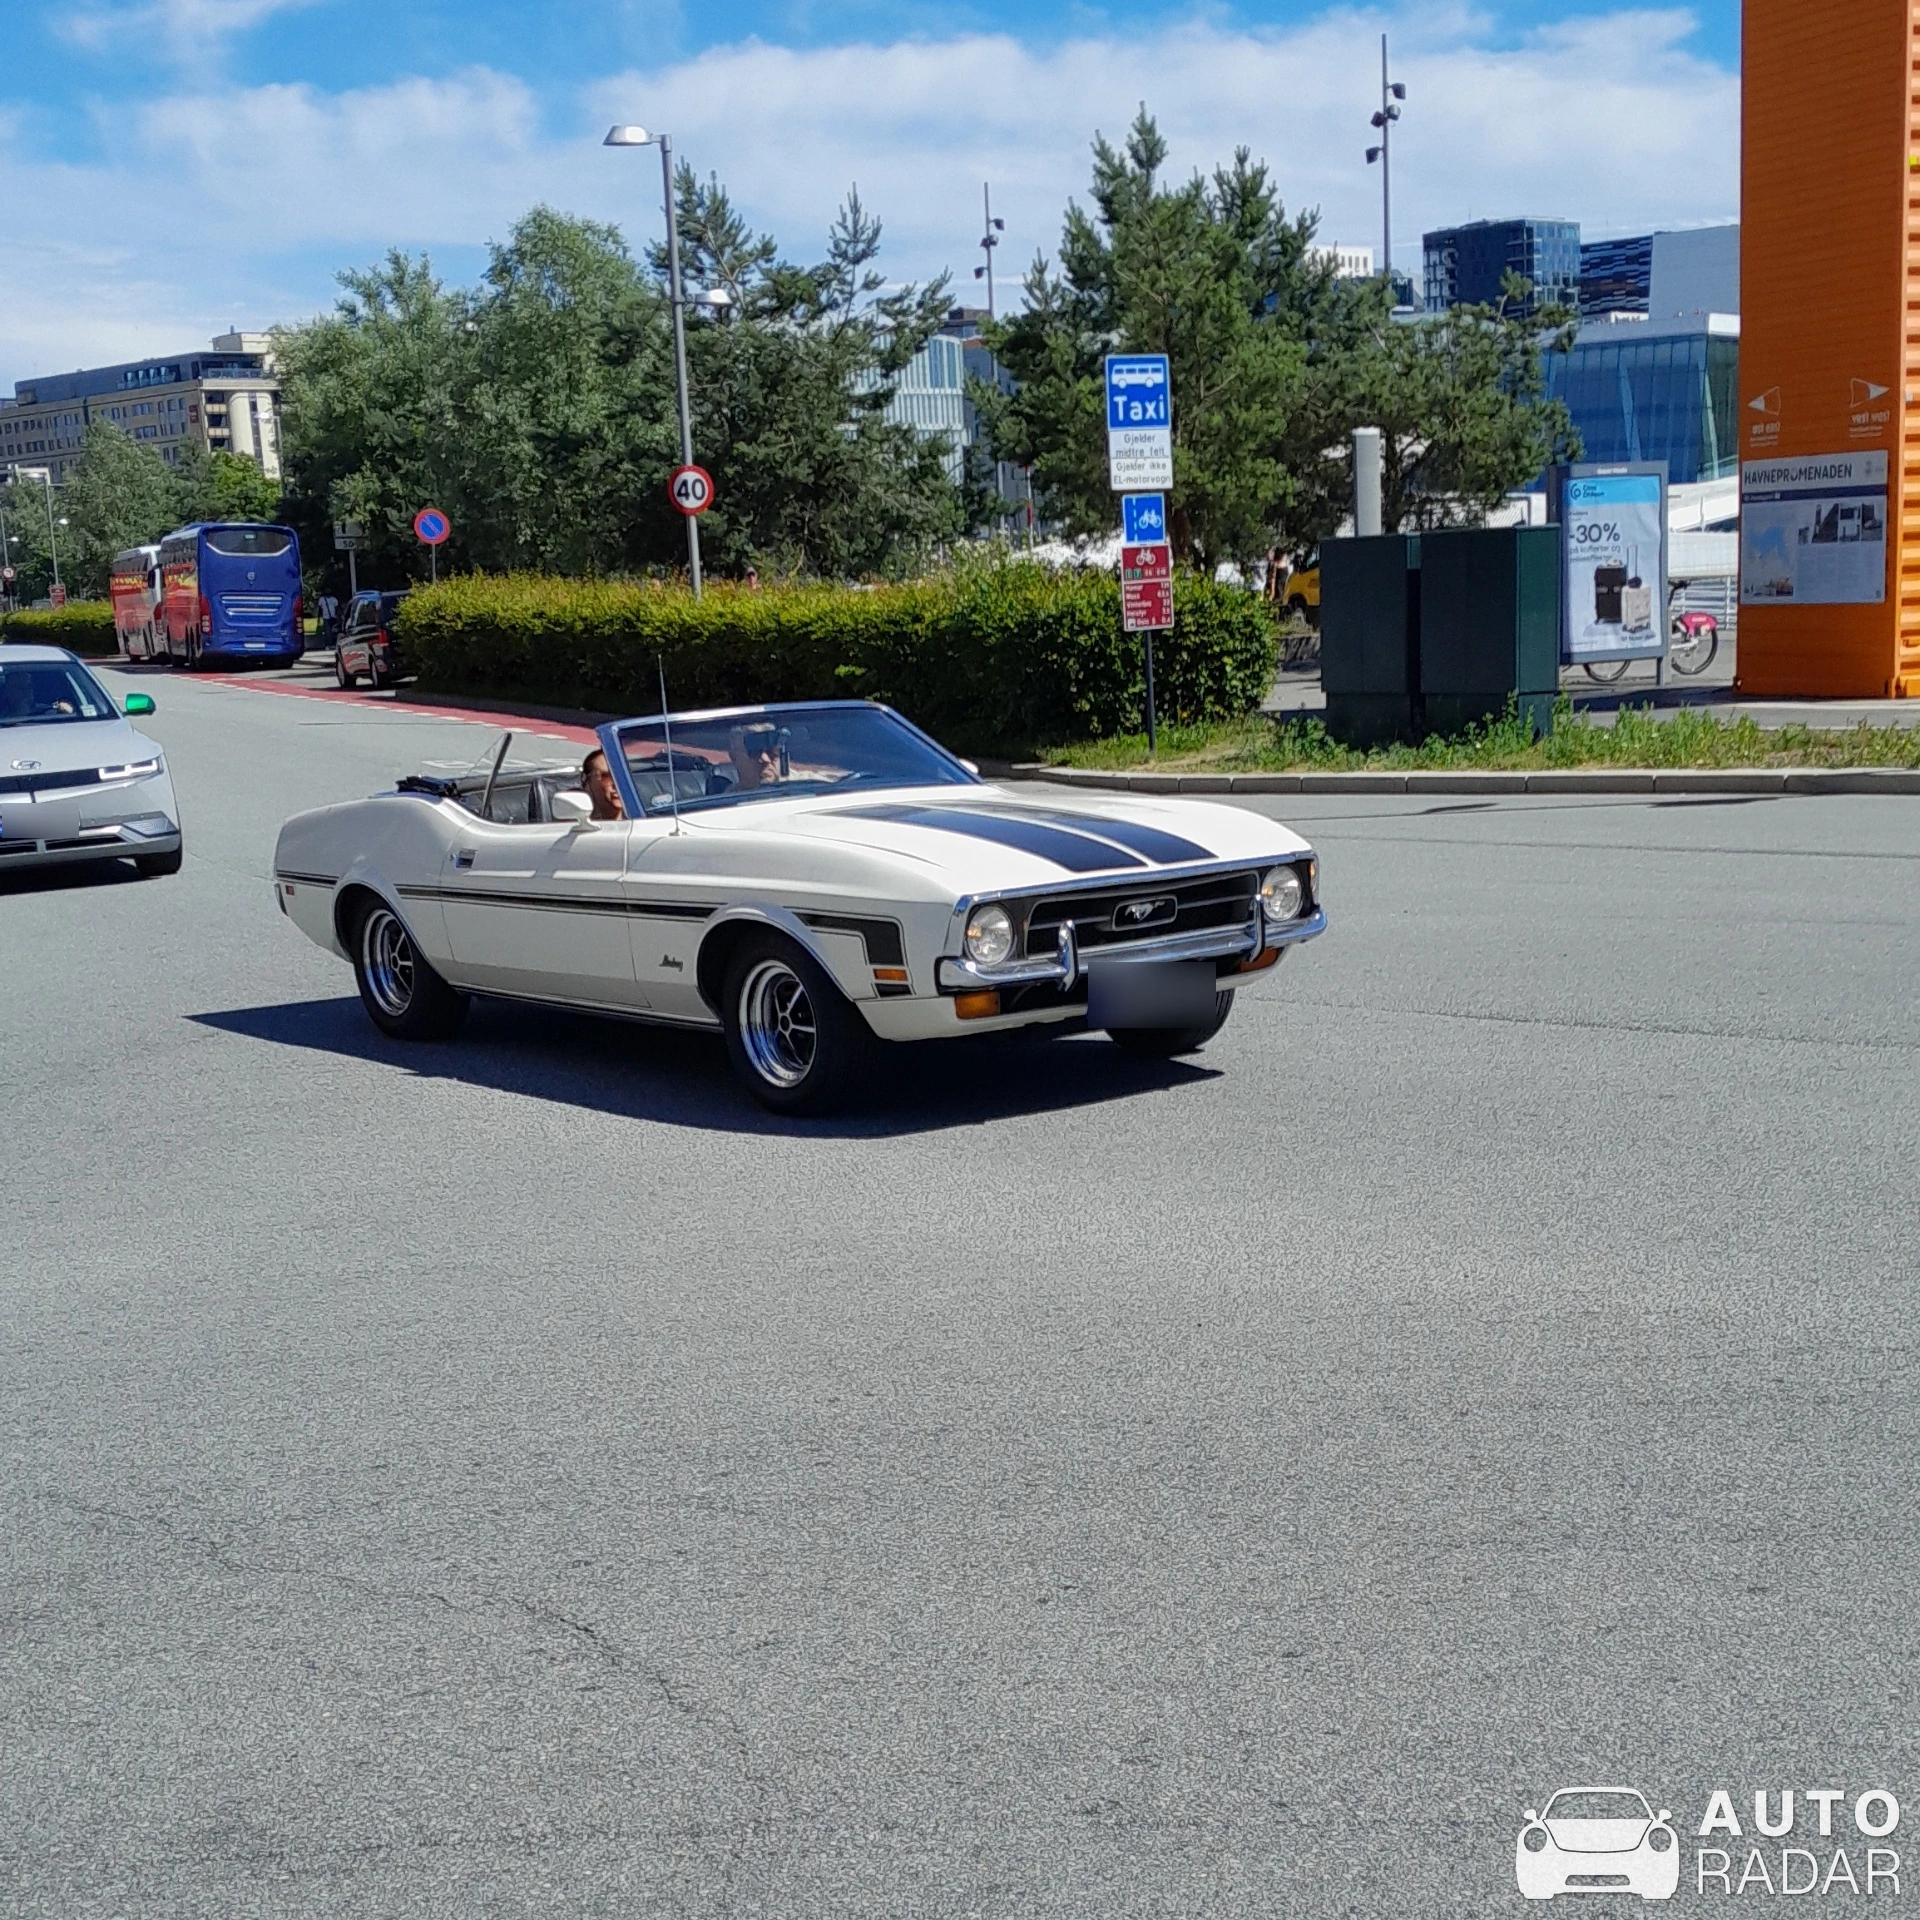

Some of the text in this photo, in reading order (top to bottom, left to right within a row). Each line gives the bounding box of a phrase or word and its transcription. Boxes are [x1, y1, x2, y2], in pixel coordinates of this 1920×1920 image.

[1113, 394, 1165, 421] Taxi
[1123, 433, 1156, 445] Gjelder
[1115, 446, 1145, 458] midtre
[1116, 461, 1167, 473] Gjelder ikke
[676, 478, 706, 501] 40
[1569, 521, 1621, 544] -30%
